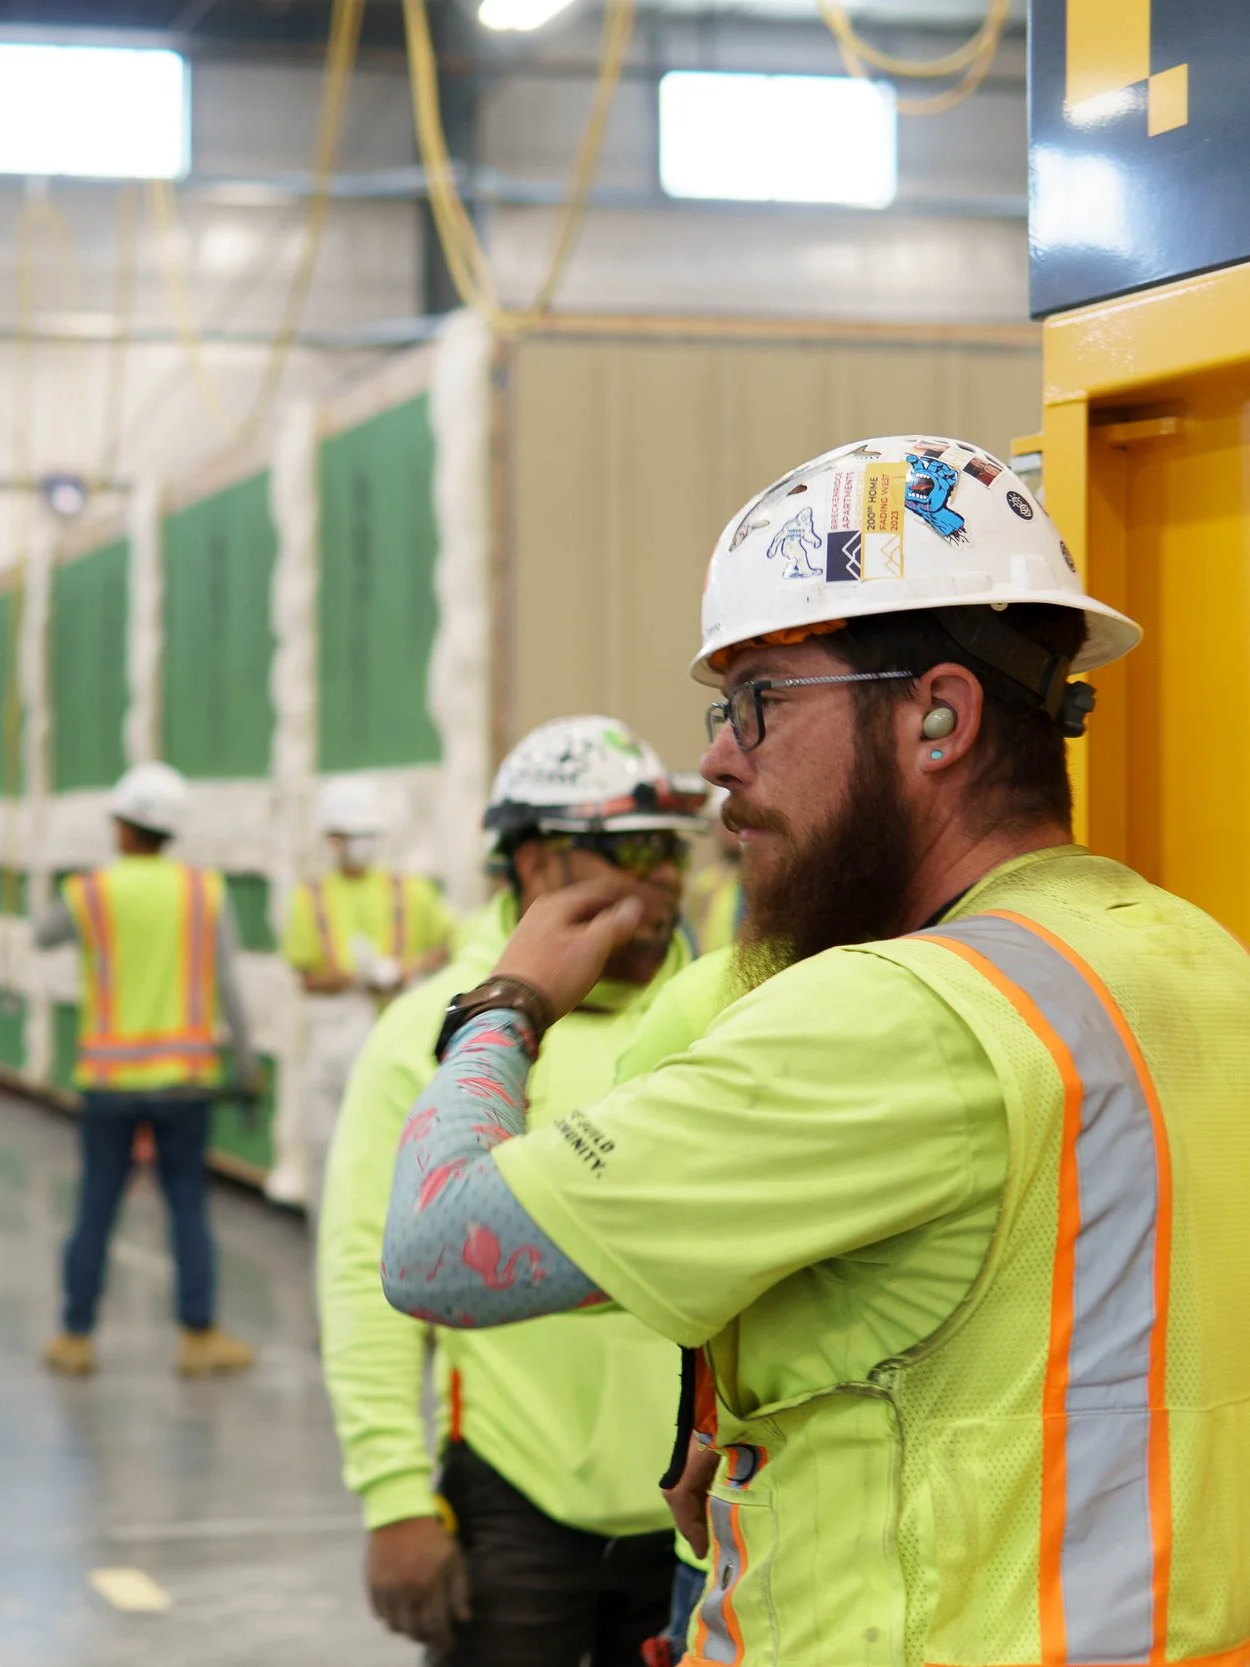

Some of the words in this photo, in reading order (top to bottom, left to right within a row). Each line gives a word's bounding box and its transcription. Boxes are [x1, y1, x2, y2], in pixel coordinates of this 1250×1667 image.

[869, 477, 878, 503] HOME
[882, 474, 890, 496] WEST
[831, 472, 842, 530] BRECKENRIDGE
[842, 471, 854, 529] APARTMENTS
[879, 497, 888, 530] FADING
[890, 510, 899, 531] 2023
